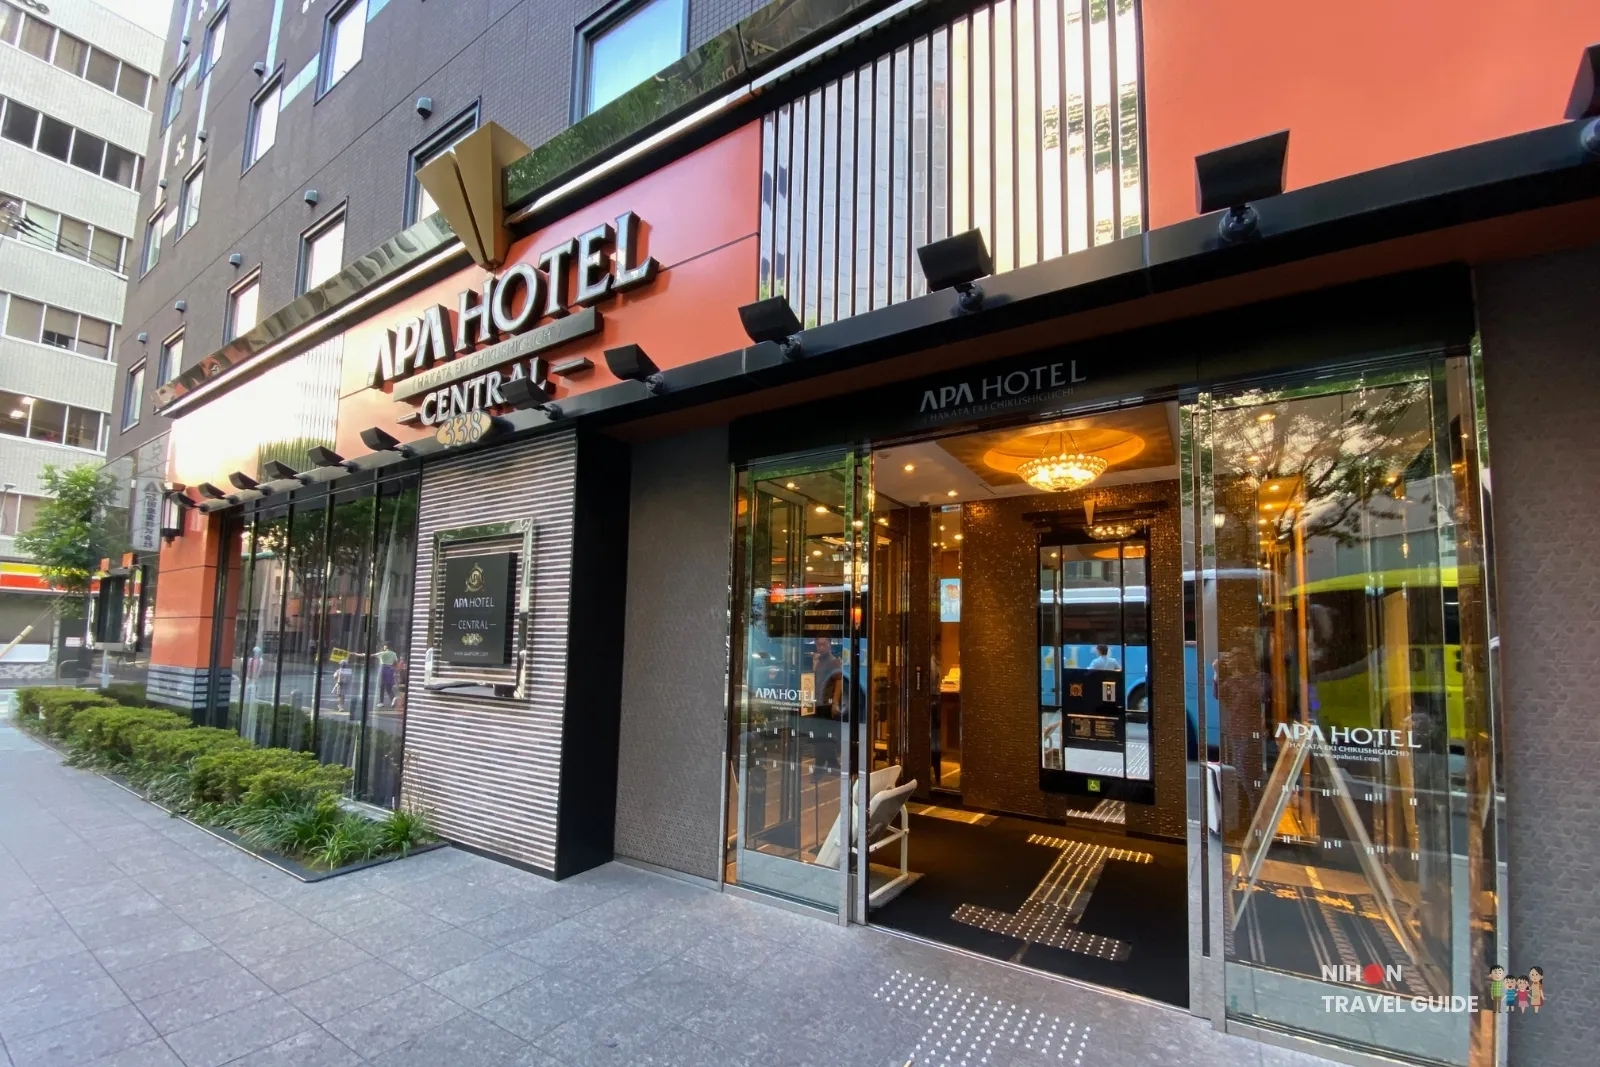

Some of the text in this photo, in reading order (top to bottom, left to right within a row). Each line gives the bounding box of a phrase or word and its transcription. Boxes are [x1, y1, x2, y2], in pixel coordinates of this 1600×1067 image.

[367, 211, 658, 389] APA HOTEL
[919, 360, 1087, 412] APA HOTEL
[442, 409, 483, 449] 338
[454, 597, 495, 608] APA HOTEL
[458, 620, 488, 629] CENTRAL
[755, 687, 817, 701] APA HOTEL
[1274, 722, 1422, 748] APA HOTEL
